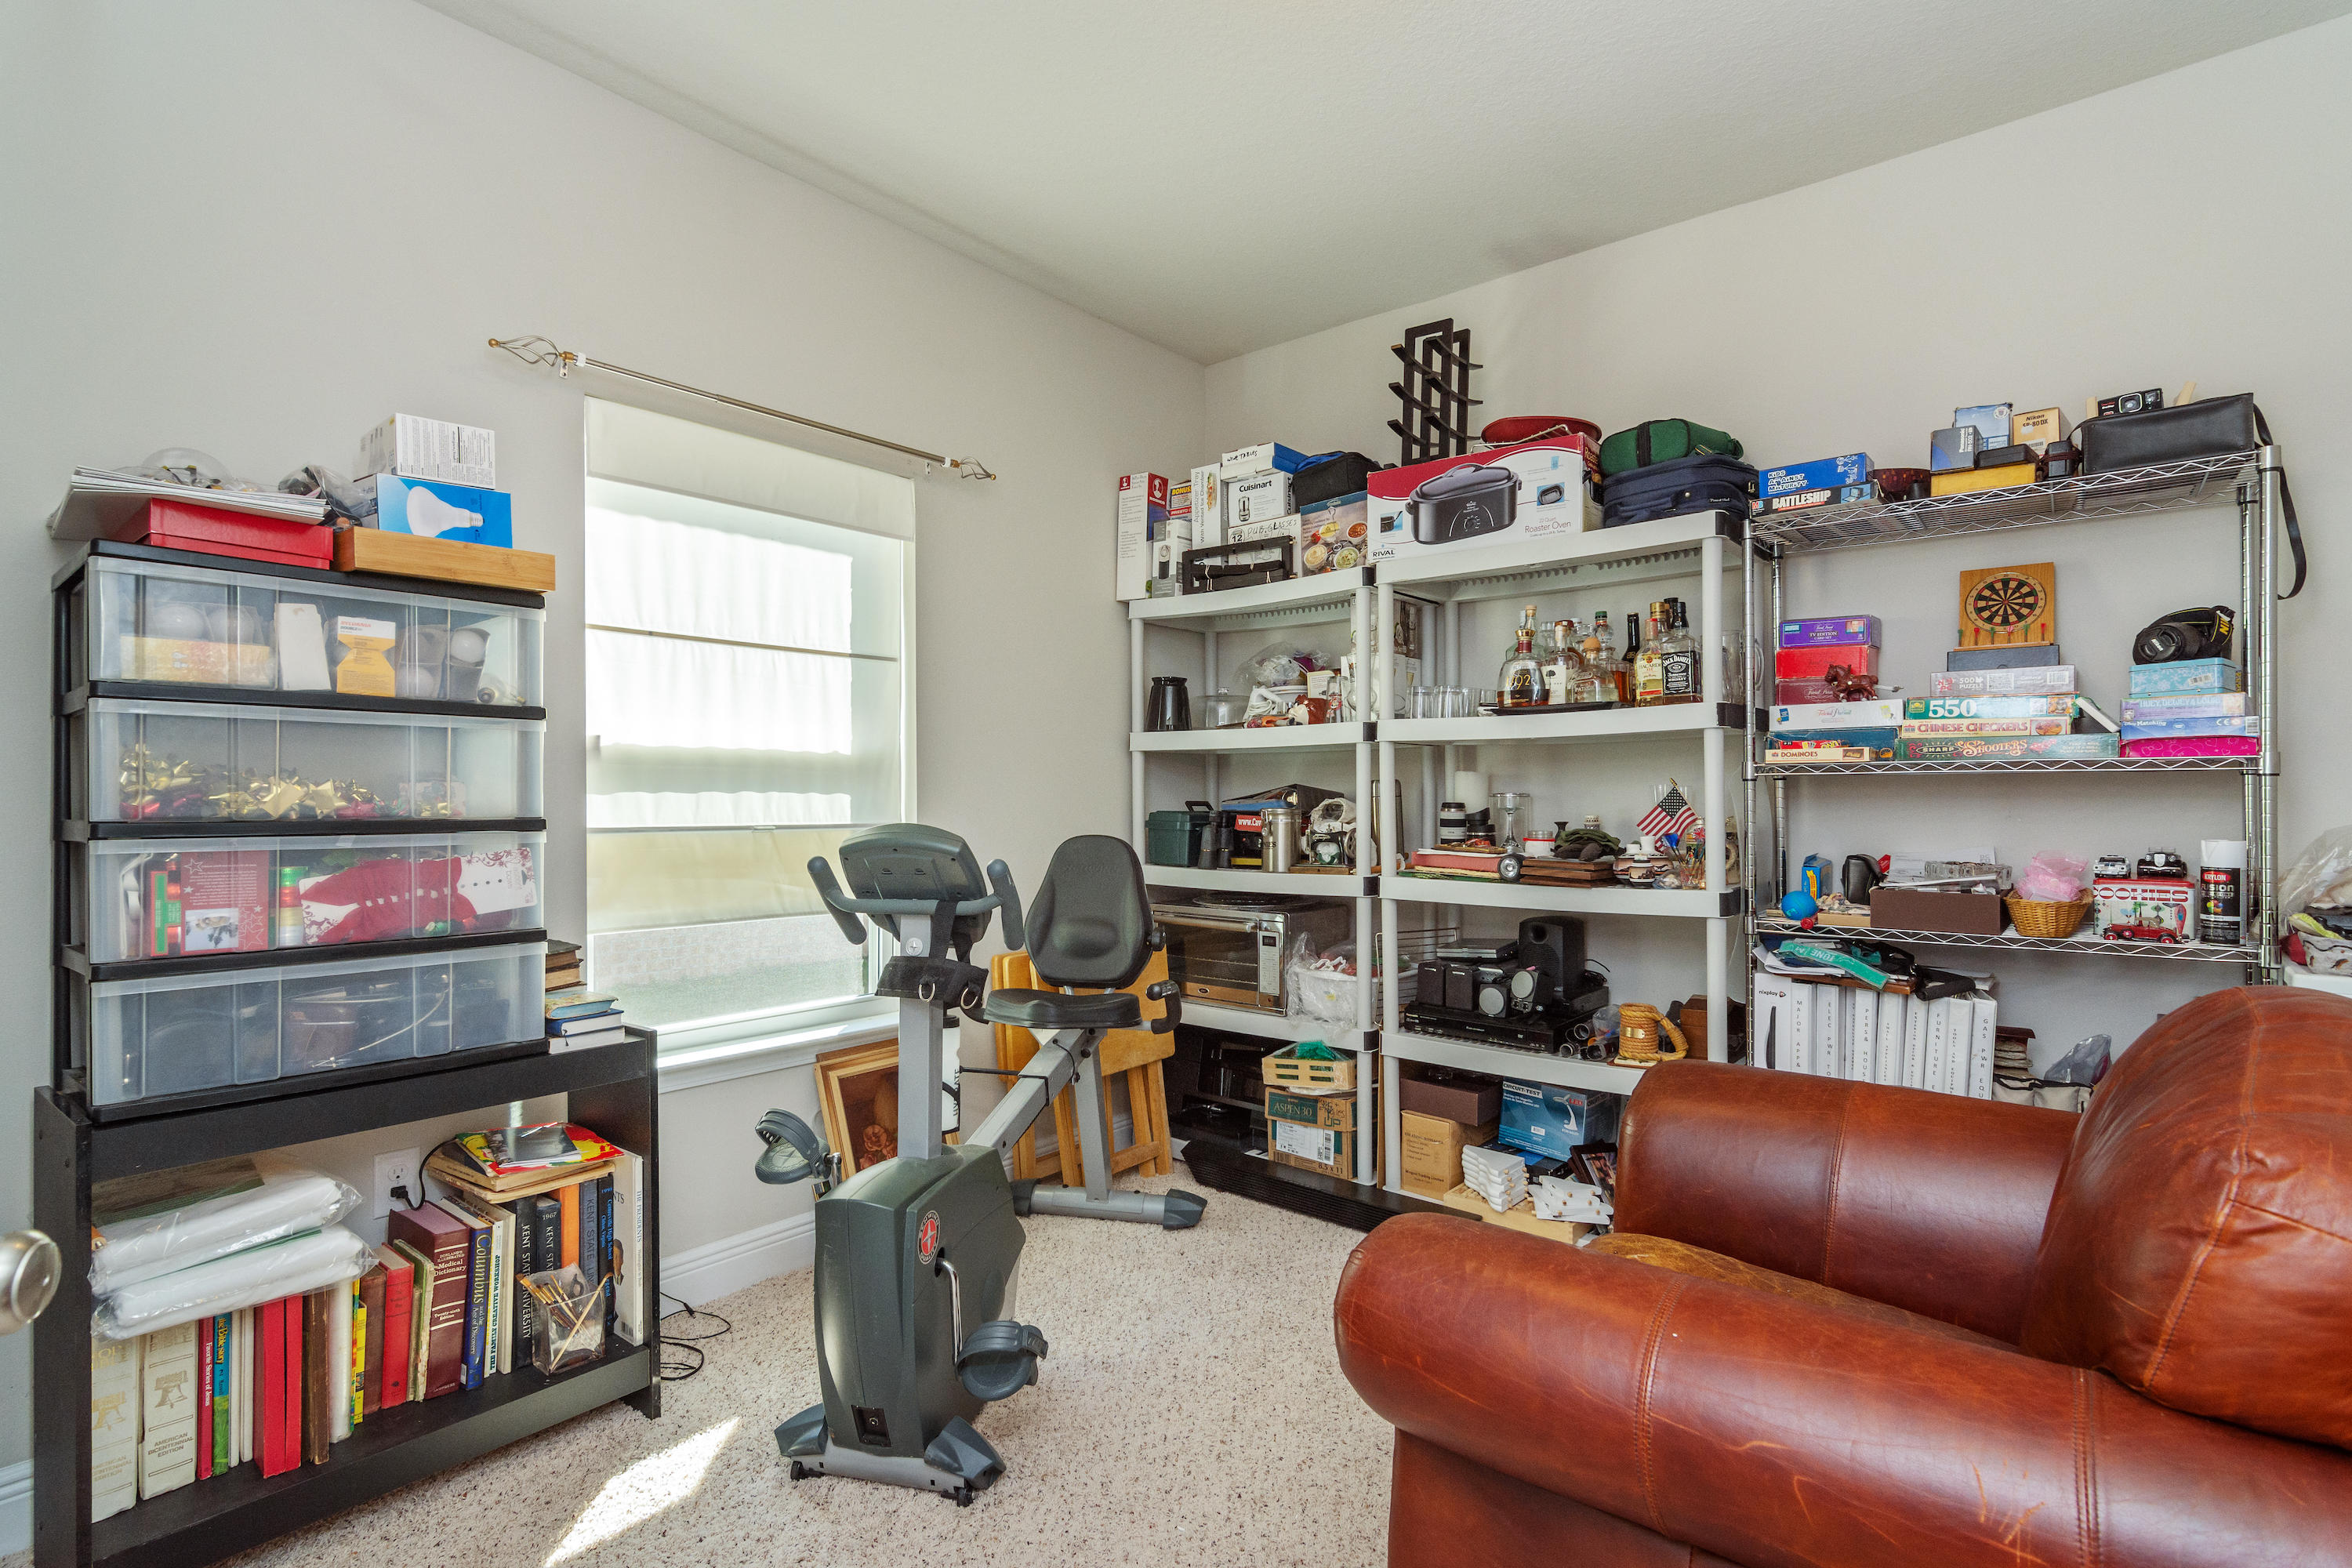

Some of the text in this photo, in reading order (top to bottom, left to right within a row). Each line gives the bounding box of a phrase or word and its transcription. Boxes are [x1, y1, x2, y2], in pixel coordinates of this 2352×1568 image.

[2026, 413, 2045, 422] Nikon
[1239, 480, 1272, 492] Cuisinart
[1772, 490, 1831, 510] BATTLESHIP
[1525, 521, 1571, 534] Roaster Oven
[1663, 657, 1674, 666] JACK
[1929, 699, 1976, 717] 550
[1917, 722, 2028, 733] CHINESE CHECKERS
[1955, 739, 2027, 757] SHOOTERS
[1503, 1083, 1541, 1097] CIRCUIT-TEST
[1273, 1102, 1301, 1115] ASPEN
[1301, 1107, 1312, 1117] 30
[587, 1229, 596, 1262] STATE
[434, 1265, 466, 1276] Dictionary
[438, 1259, 463, 1269] Medical
[473, 1234, 492, 1304] Columbus
[219, 1326, 228, 1347] Bible
[147, 1436, 194, 1456] BICENTENNIAL
[154, 1432, 188, 1447] AMERICAN
[158, 1444, 184, 1458] EDITION
